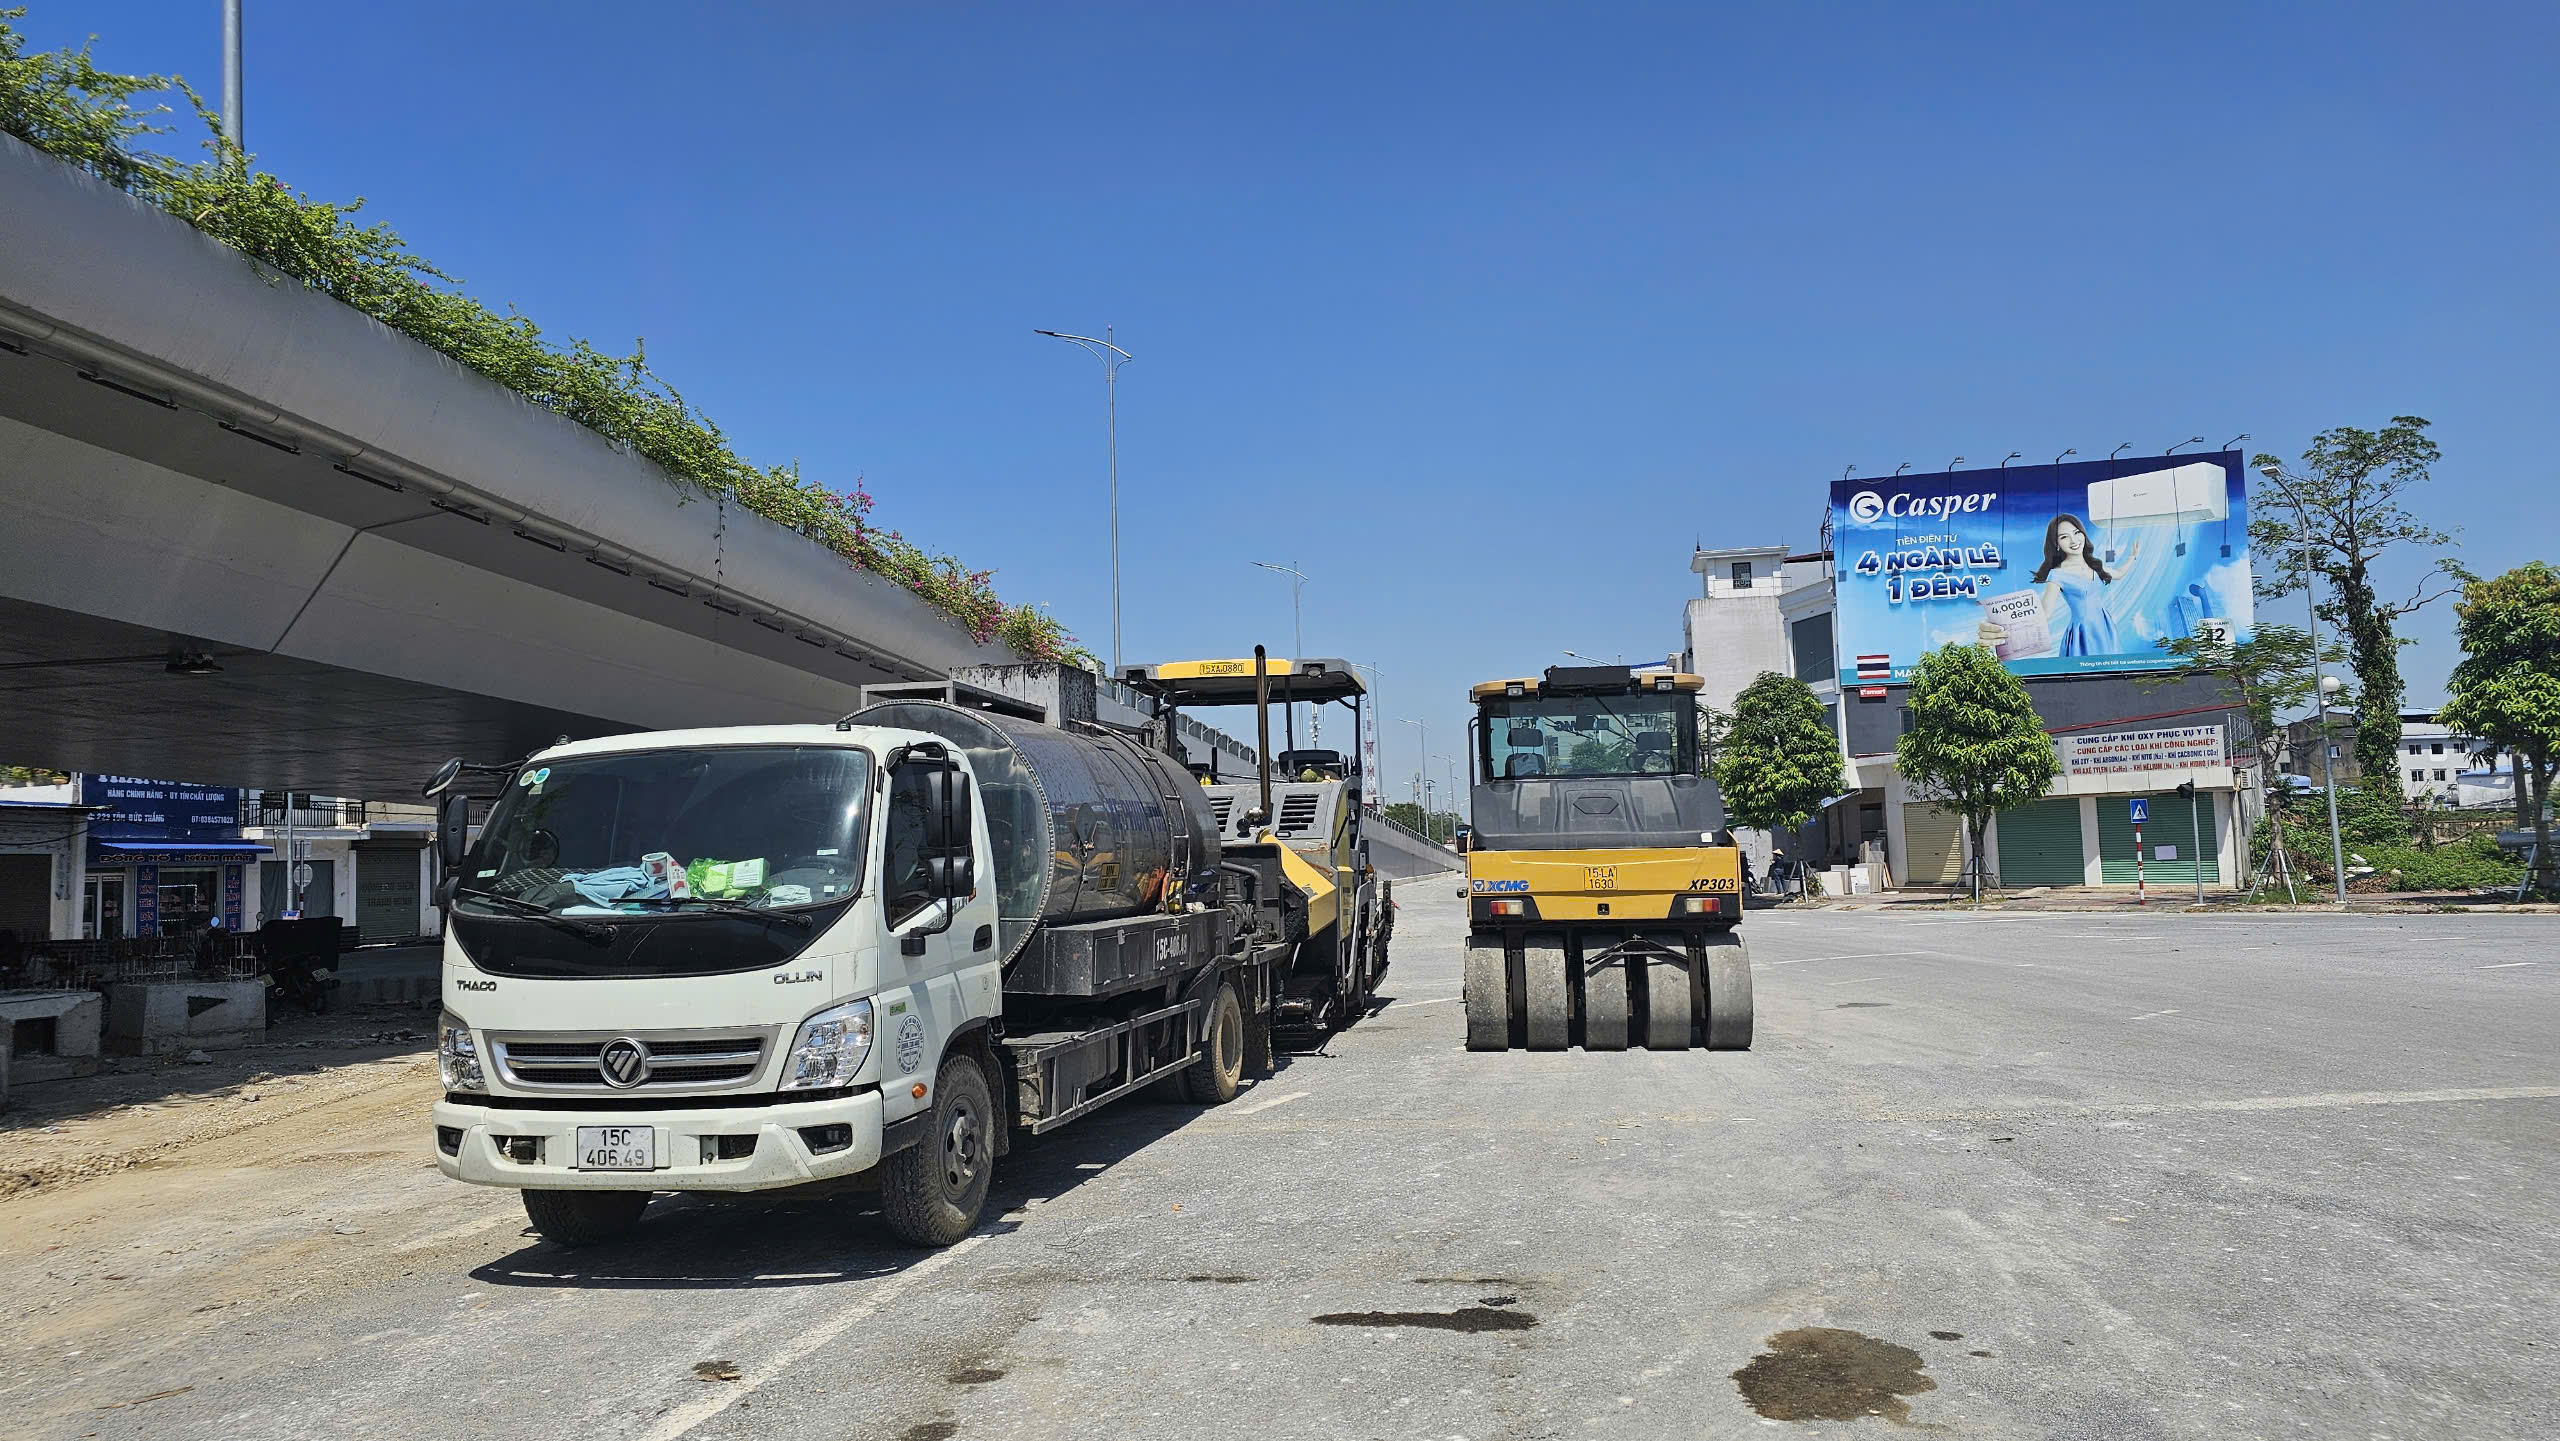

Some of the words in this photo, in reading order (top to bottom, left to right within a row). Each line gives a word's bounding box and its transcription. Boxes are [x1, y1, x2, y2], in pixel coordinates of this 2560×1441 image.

[1887, 492, 1997, 522] Casper
[1896, 535, 1918, 546] TIỀN
[1919, 533, 1942, 545] ĐIỆN
[1857, 551, 1881, 575] 4
[1886, 546, 1963, 572] NGÀN
[1966, 542, 2001, 567] LẺ
[1888, 576, 1904, 603] 1
[2077, 737, 2099, 745] CUNG
[2102, 733, 2118, 743] CẤP
[2121, 732, 2135, 741] KHÍ
[2138, 732, 2154, 740] OXY
[2157, 730, 2180, 741] PHỤC
[2183, 730, 2194, 738] VỤ
[2077, 746, 2096, 755] CUNG
[2099, 744, 2112, 753] CẤP
[2115, 743, 2130, 752] CÁC
[2131, 743, 2147, 752] LOẠI
[2150, 741, 2162, 750] KHÍ
[2164, 739, 2185, 749] CÔNG
[108, 788, 124, 798] HÀNG
[126, 789, 145, 799] CHÍNH
[170, 791, 178, 800] UY
[1486, 880, 1529, 891] XCMG
[1589, 879, 1614, 889] 1630
[1688, 879, 1735, 890] XP303
[773, 971, 823, 985] OLLIN
[457, 980, 498, 992] THACO
[601, 1129, 631, 1147] 15C
[586, 1149, 645, 1167] 406.49
